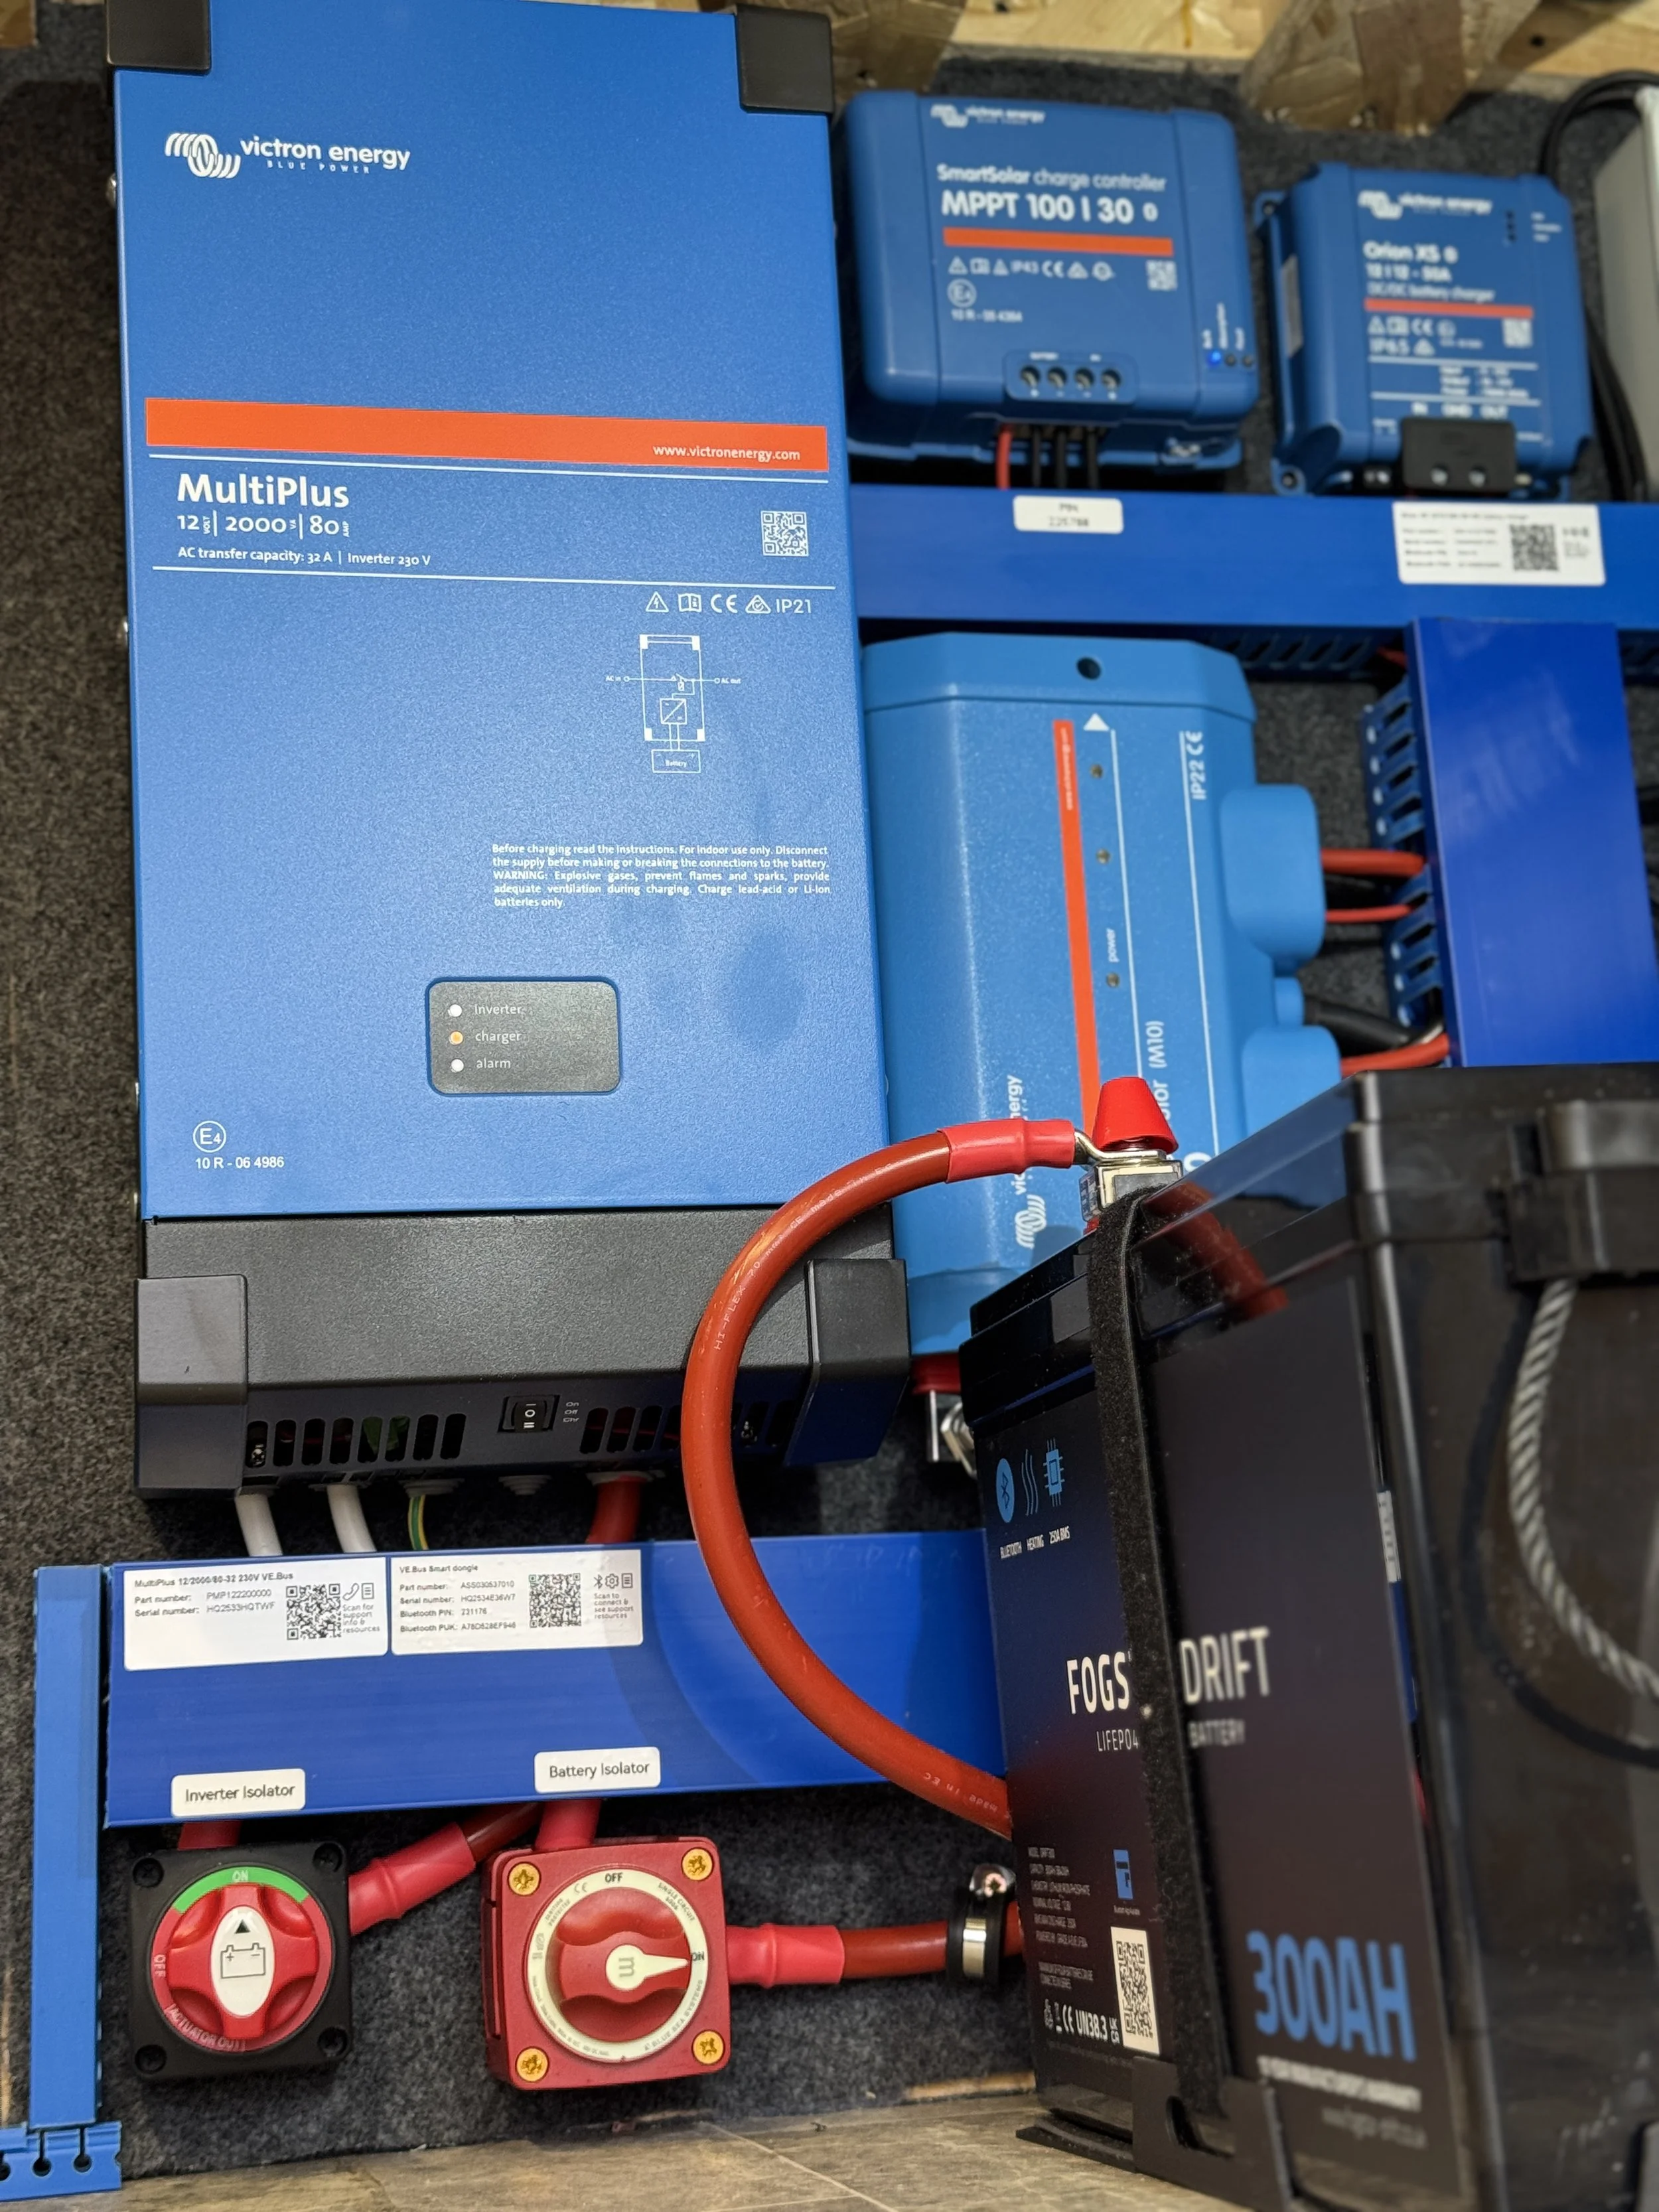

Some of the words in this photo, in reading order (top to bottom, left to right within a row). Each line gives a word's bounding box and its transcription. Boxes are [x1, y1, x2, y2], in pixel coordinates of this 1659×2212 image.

[240, 135, 322, 160] victron
[328, 143, 411, 171] energy
[267, 160, 307, 171] BLUE
[319, 162, 370, 175] POWER
[937, 163, 1031, 184] SmartSolar
[1033, 167, 1090, 191] charge
[1092, 173, 1167, 192] controller
[941, 188, 1019, 218] MPPT
[1025, 192, 1075, 222] 100
[1097, 197, 1135, 224] 30
[1363, 240, 1413, 261] Orion
[652, 445, 800, 463] www.victronenergy.com
[177, 473, 350, 508] MultiPlus
[177, 515, 200, 531] 12
[225, 516, 287, 534] 2000
[309, 515, 340, 535] 80
[178, 546, 196, 558] AC
[198, 548, 248, 561] transfer
[250, 550, 305, 565] capacity:
[307, 553, 322, 564] 32
[323, 553, 332, 563] A
[348, 553, 396, 565] Inverter
[398, 556, 420, 567] 230
[421, 555, 431, 565] V
[776, 598, 812, 614] IP21
[665, 759, 687, 769] Battery
[1189, 761, 1208, 800] IP22
[492, 844, 525, 853] Before
[527, 844, 571, 856] charging
[573, 844, 595, 854] read
[597, 844, 614, 854] the
[616, 845, 676, 855] instructions.
[679, 845, 695, 855] For
[697, 845, 729, 855] indoor
[749, 845, 773, 857] only.
[775, 845, 828, 855] Disconnect
[492, 857, 510, 867] the
[512, 858, 546, 869] supply
[547, 857, 580, 867] before
[583, 857, 620, 869] making
[635, 857, 679, 869] breaking
[680, 857, 697, 867] the
[699, 857, 760, 868] connections
[762, 859, 770, 868] to
[772, 858, 789, 868] the
[791, 858, 830, 870] battery.
[493, 871, 549, 881] WARNING:
[553, 871, 601, 883] Explosive
[607, 872, 639, 883] gases,
[644, 873, 683, 883] prevent
[689, 870, 723, 881] flames
[729, 871, 747, 881] and
[753, 871, 788, 883] sparks,
[793, 871, 830, 883] provide
[493, 884, 542, 896] adequate
[547, 884, 601, 894] ventilation
[607, 884, 640, 896] during
[646, 884, 692, 897] charging.
[697, 884, 733, 896] Charge
[738, 884, 782, 894] lead-acid
[494, 897, 540, 907] batteries
[541, 897, 566, 909] only.
[1106, 928, 1119, 963] power
[474, 1030, 522, 1045] charger
[1145, 1020, 1168, 1069] (M10)
[476, 1059, 511, 1069] alarm
[195, 1157, 211, 1169] 10
[213, 1157, 224, 1169] R
[235, 1156, 251, 1169] 06
[253, 1155, 285, 1169] 4986
[452, 1564, 478, 1573] dongle
[134, 1579, 175, 1587] MultiPlus
[134, 1595, 153, 1604] Part
[134, 1608, 160, 1617] Serial
[162, 1607, 200, 1615] number:
[1179, 1625, 1270, 1705] DRIFT
[1188, 1718, 1246, 1749] BATTERY
[549, 1765, 597, 1781] Battery
[601, 1761, 650, 1776] Isolator
[184, 1788, 240, 1803] Inverter
[243, 1784, 295, 1799] Isolator
[232, 1870, 250, 1882] ON
[605, 1872, 623, 1883] OFF
[691, 1952, 705, 1962] ON
[153, 1954, 167, 1978] OFF
[1246, 1929, 1418, 2063] 300AH
[1075, 2009, 1108, 2042] UN38.3
